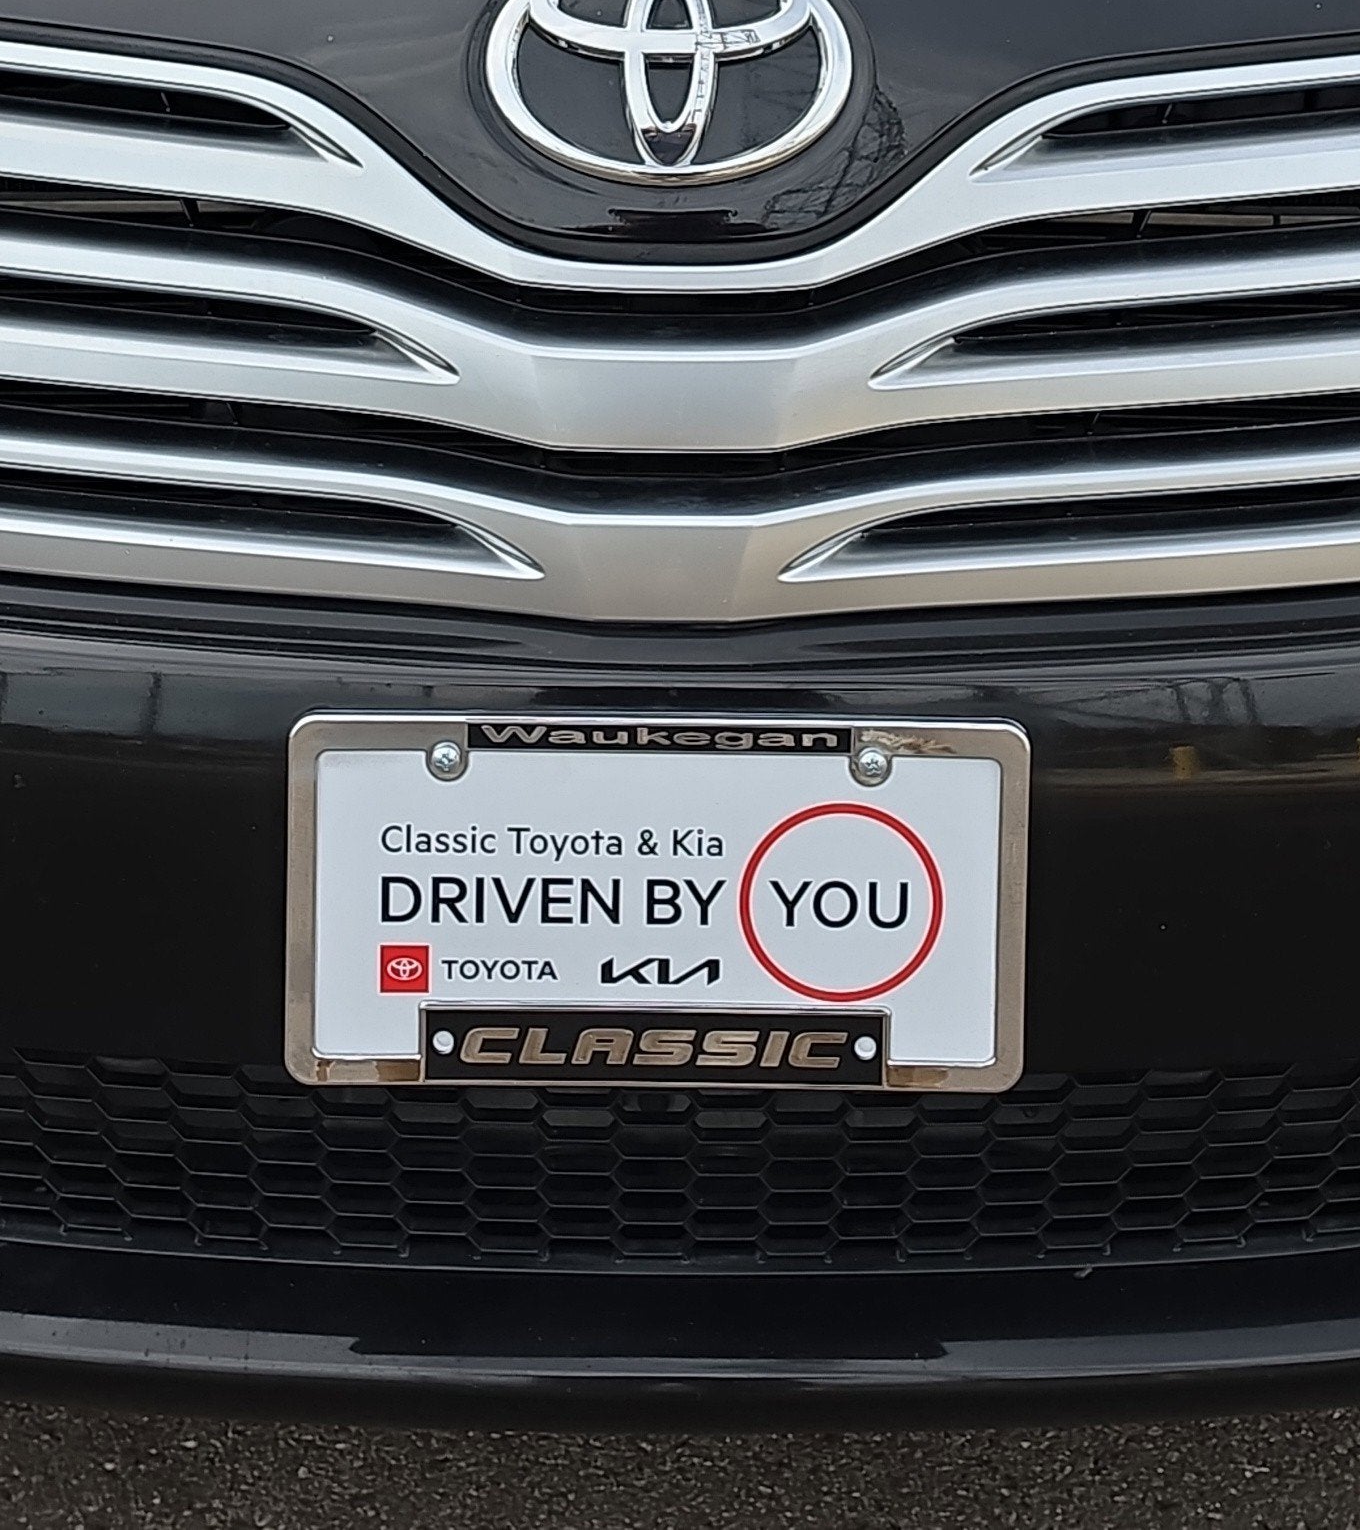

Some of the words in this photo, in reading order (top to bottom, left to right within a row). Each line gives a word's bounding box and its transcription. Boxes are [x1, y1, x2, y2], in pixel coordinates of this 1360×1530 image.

[480, 725, 839, 750] Waukegan
[380, 824, 496, 856] Classic
[506, 826, 624, 862] Toyota
[636, 829, 660, 857] &
[671, 828, 724, 858] Kia
[380, 876, 622, 925] DRIVEN
[645, 878, 727, 926] BY
[769, 880, 910, 929] YOU
[441, 958, 559, 981] TOYOTA
[460, 1027, 848, 1068] CLASSIC
